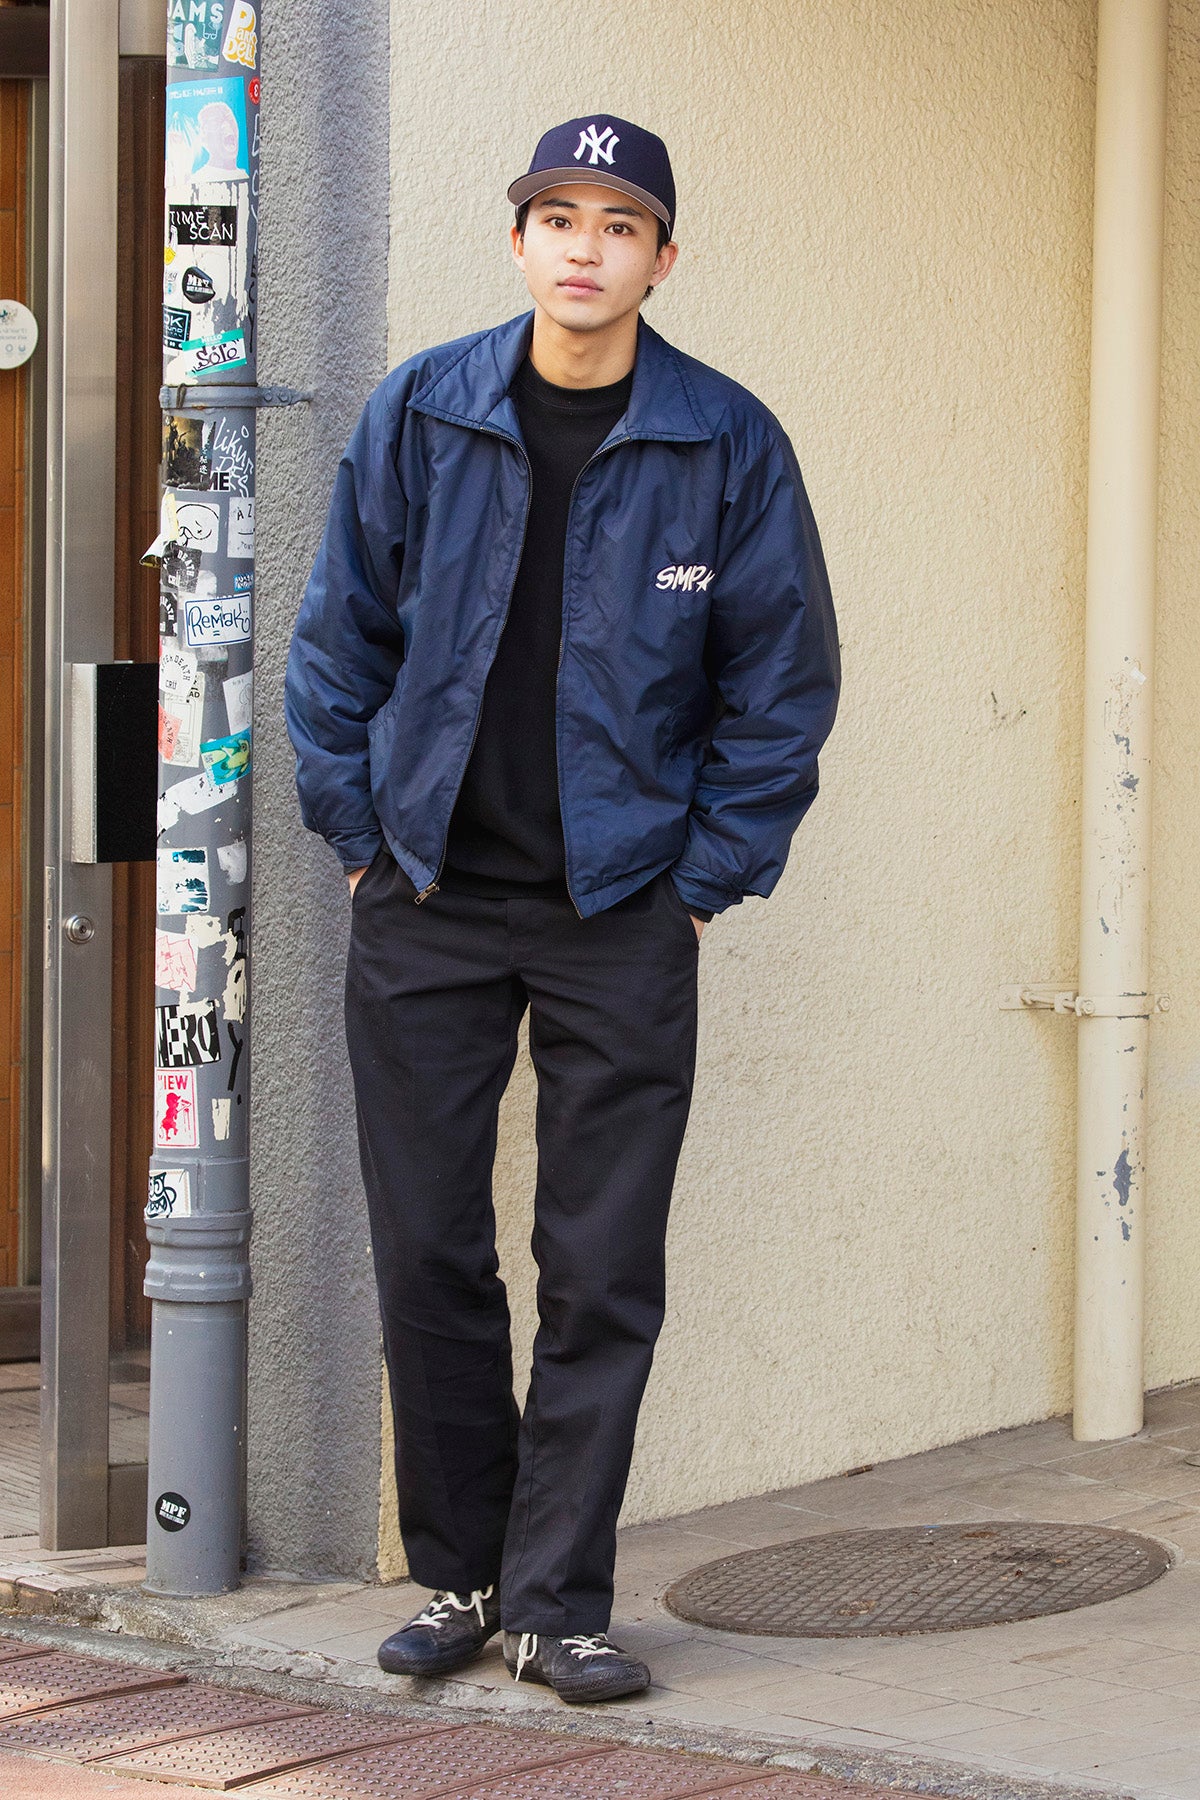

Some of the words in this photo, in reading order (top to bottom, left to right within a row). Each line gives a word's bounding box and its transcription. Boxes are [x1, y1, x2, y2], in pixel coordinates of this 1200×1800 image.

[573, 123, 620, 165] NY
[169, 210, 205, 226] TIME
[189, 222, 233, 241] SCAN
[160, 1498, 187, 1519] MPF
